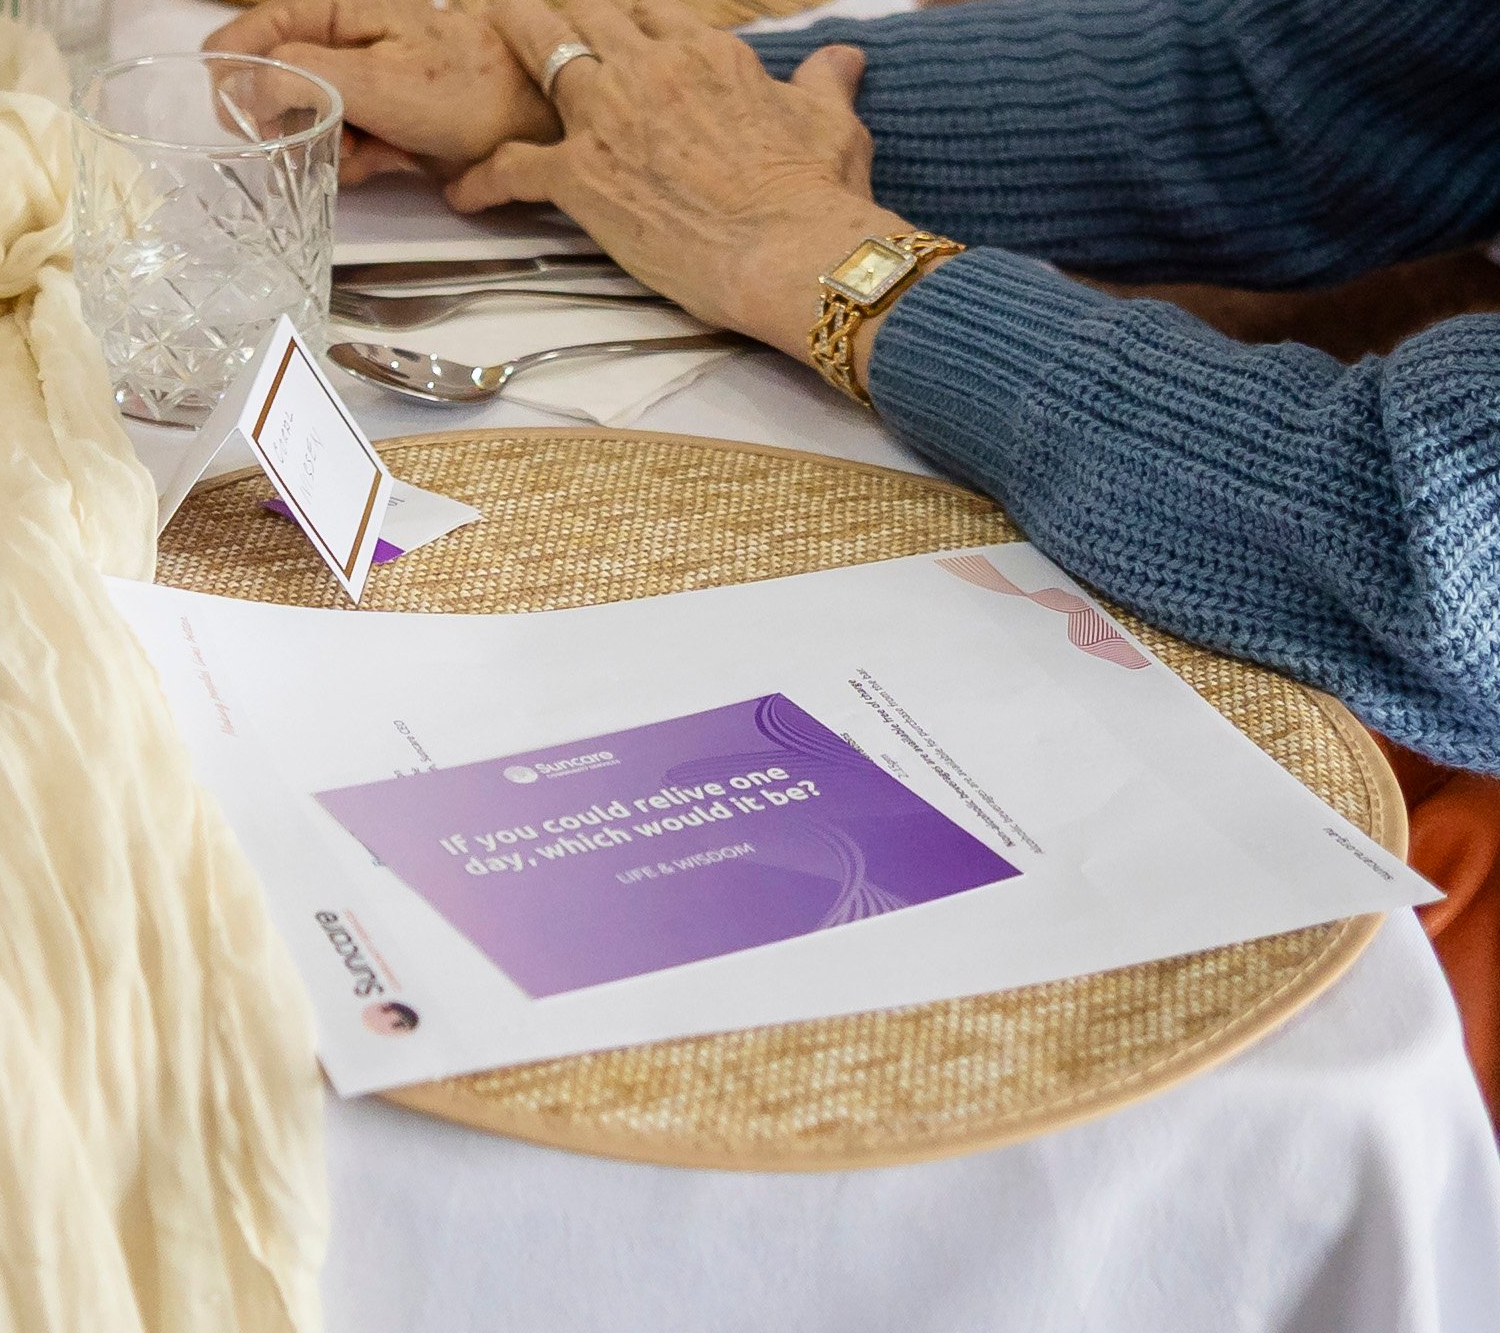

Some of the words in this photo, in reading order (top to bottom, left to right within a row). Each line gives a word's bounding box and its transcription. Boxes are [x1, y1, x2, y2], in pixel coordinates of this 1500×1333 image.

[848, 679, 873, 701] charge
[868, 679, 883, 691] the
[879, 691, 899, 707] from
[393, 720, 411, 735] CEO
[877, 709, 894, 723] free
[895, 707, 930, 737] purchase
[406, 735, 432, 762] Suncare
[890, 723, 924, 753] available
[534, 751, 614, 775] Suncare
[919, 752, 936, 765] are
[935, 747, 968, 777] available
[933, 765, 969, 799] beverages
[964, 777, 980, 789] are
[438, 832, 469, 856] If
[475, 824, 536, 854] you
[541, 799, 631, 836] could
[633, 779, 726, 816] relive
[728, 765, 791, 791] one
[977, 789, 1013, 823] beverages
[463, 848, 538, 877] day,
[534, 827, 633, 862] which
[632, 801, 733, 838] would
[729, 793, 766, 816] it
[764, 779, 822, 807] be?
[965, 799, 1015, 848] Non-alcoholic
[1010, 822, 1045, 854] Alcoholic
[615, 862, 658, 885] LIFE
[659, 859, 676, 876] &
[674, 842, 756, 872] WISDOM
[314, 911, 385, 997] Suncare
